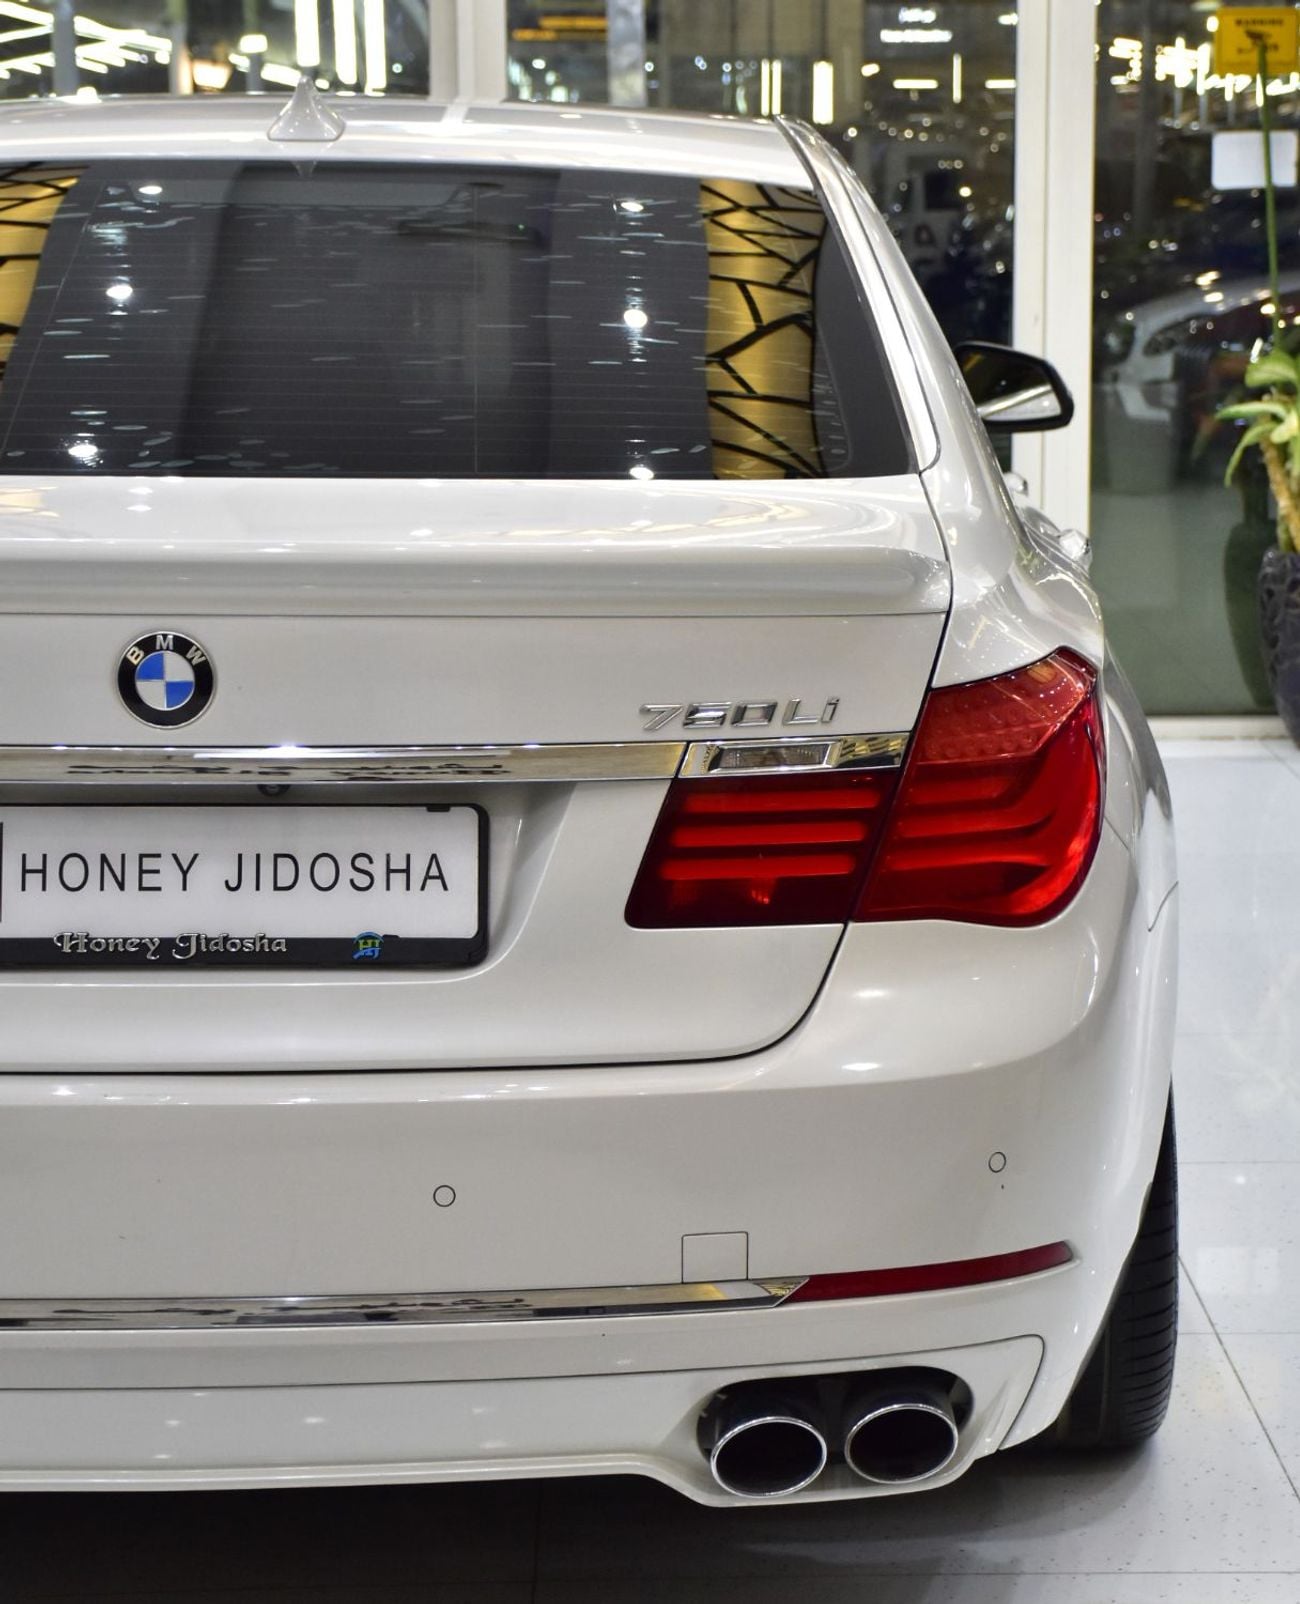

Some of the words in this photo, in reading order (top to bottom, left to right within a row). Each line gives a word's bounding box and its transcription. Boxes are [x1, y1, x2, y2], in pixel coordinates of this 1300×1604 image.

[126, 634, 207, 667] BMW
[639, 696, 841, 731] 750Li
[20, 852, 200, 892] HONEY
[224, 852, 449, 892] JIDOSHA
[53, 932, 161, 960] Honey
[172, 932, 288, 960] Jidosha
